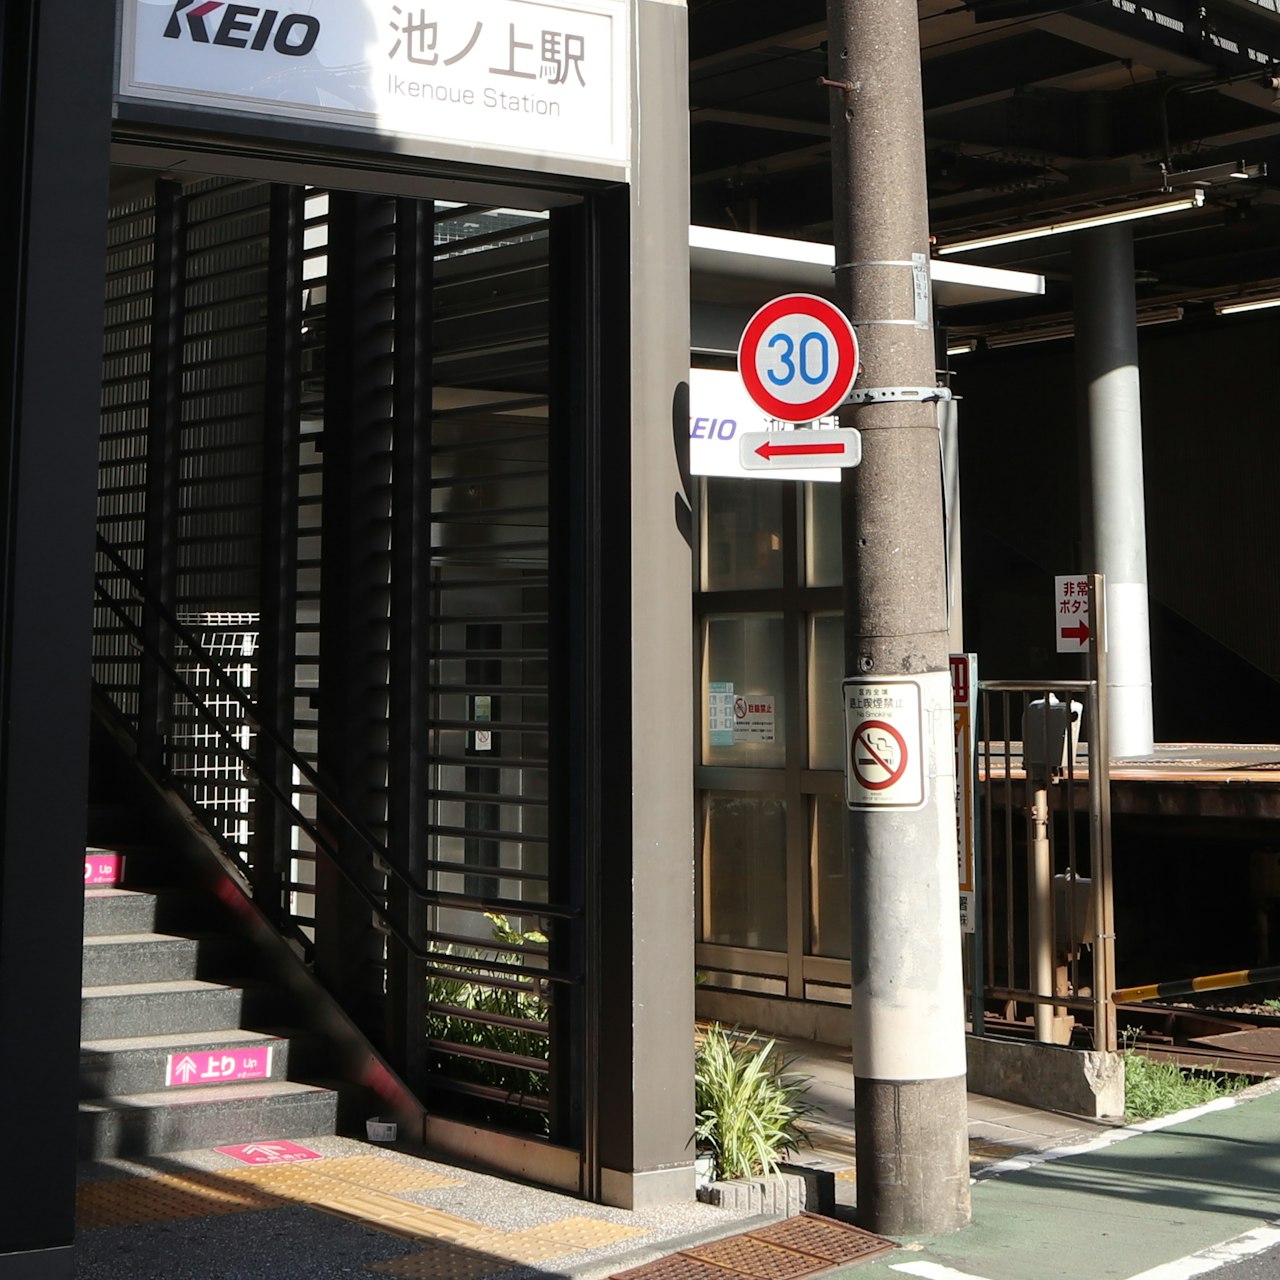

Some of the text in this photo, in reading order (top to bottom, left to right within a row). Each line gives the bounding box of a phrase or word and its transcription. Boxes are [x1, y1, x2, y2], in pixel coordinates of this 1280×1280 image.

[387, 4, 587, 89] 池ノ上駅
[387, 73, 561, 118] Ikenoue Station
[766, 331, 830, 387] 30
[690, 417, 737, 441] EIO
[1063, 581, 1088, 597] 非常
[98, 864, 113, 875] Up
[200, 1056, 258, 1078] 上り Up
